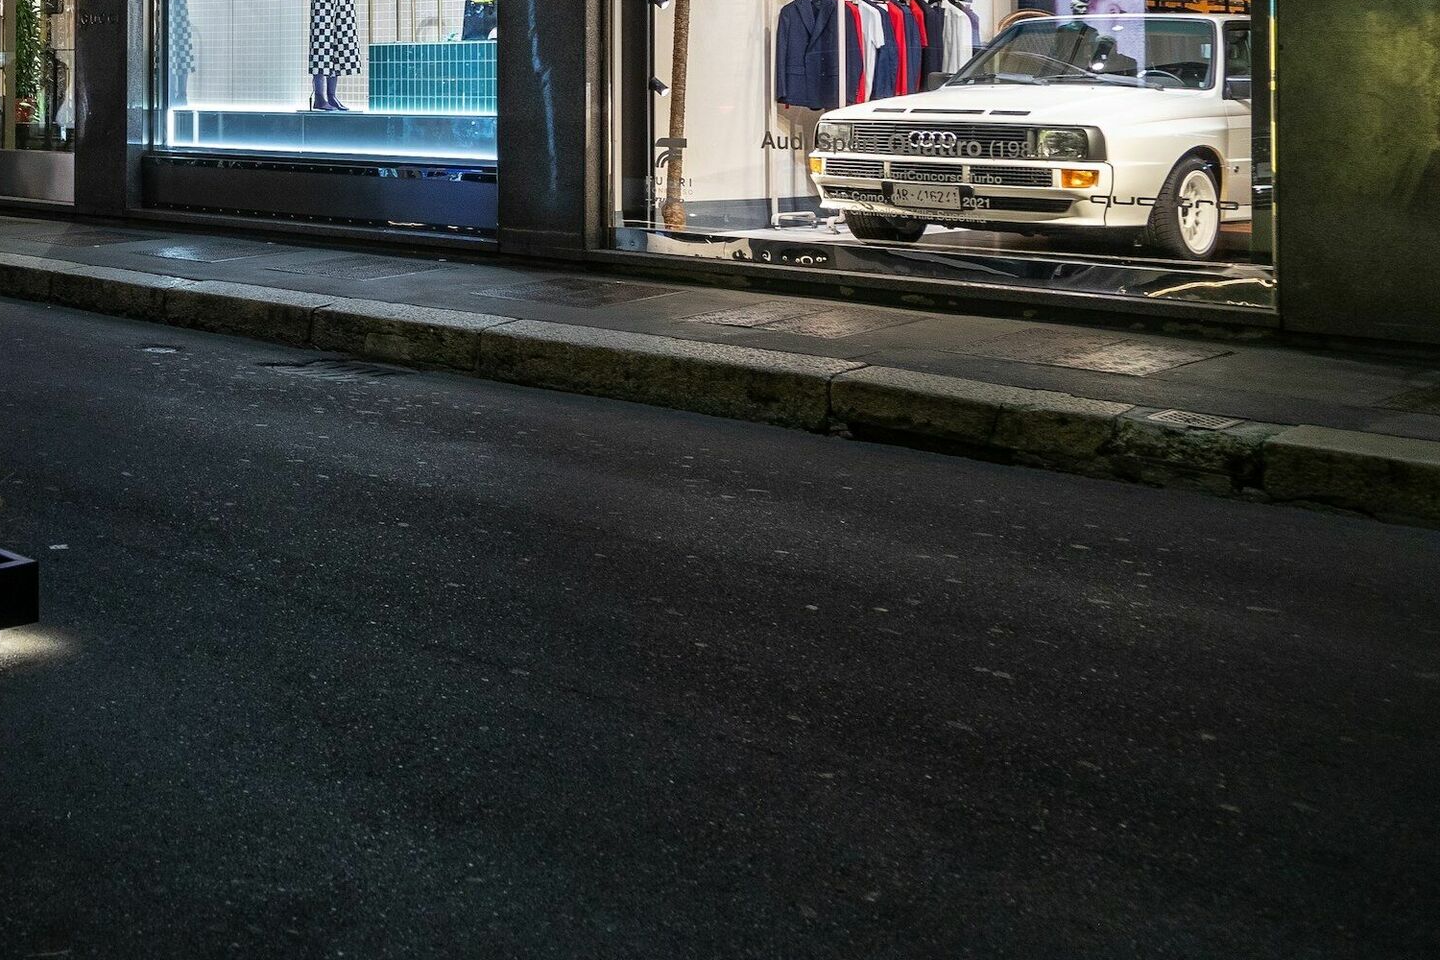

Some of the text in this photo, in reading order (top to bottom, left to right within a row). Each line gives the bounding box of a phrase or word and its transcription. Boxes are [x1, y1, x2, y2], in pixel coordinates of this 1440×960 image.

[645, 175, 692, 187] FURI
[962, 196, 991, 208] 2021
[1090, 195, 1239, 210] quatro
